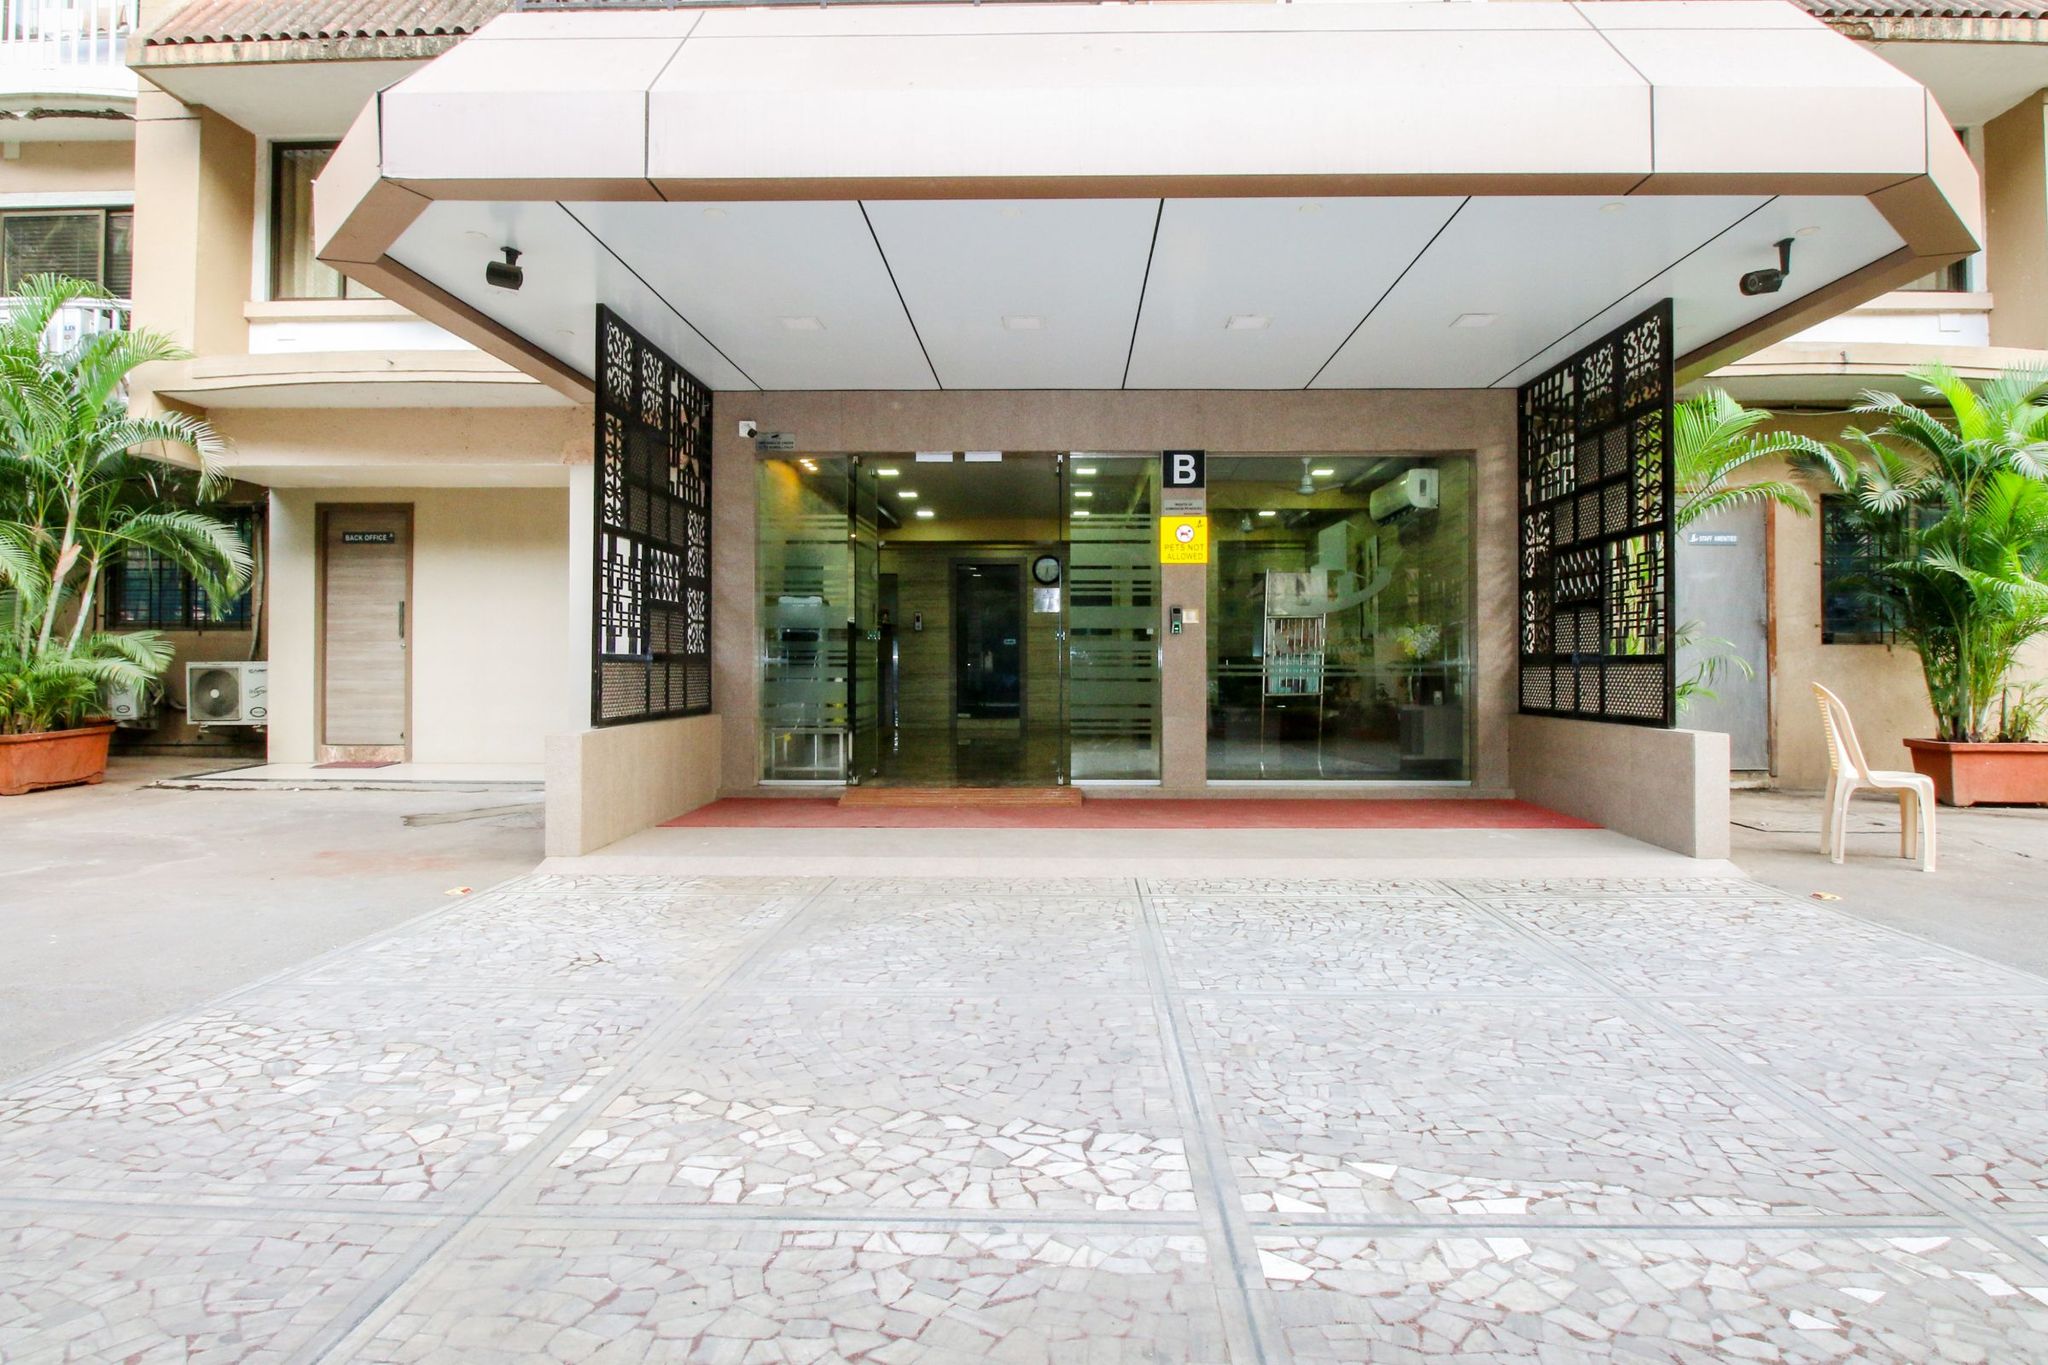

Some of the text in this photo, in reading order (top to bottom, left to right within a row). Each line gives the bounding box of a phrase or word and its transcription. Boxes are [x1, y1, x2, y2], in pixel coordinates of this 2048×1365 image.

[1173, 454, 1197, 484] B
[1164, 543, 1204, 552] PETS NOT
[1167, 552, 1204, 561] ALLOWED
